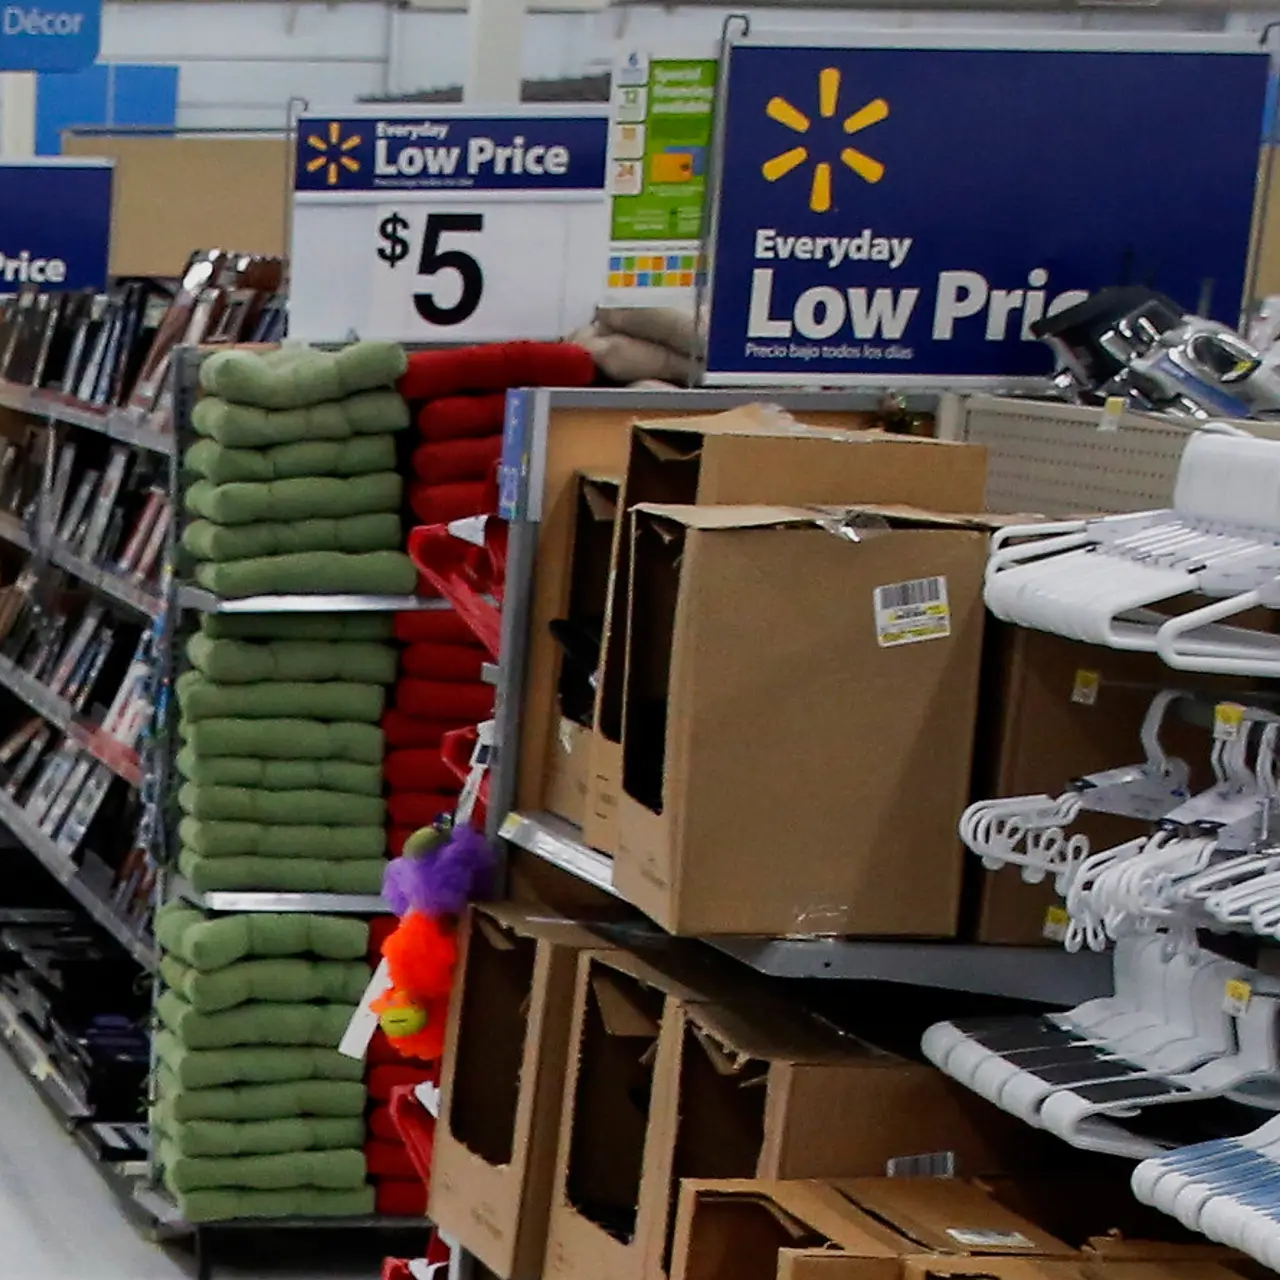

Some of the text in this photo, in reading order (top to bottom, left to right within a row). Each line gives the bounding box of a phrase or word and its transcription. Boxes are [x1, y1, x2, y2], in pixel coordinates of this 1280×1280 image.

[3, 7, 84, 36] Décor
[374, 121, 449, 139] Everyday
[373, 136, 570, 176] Low Price
[754, 229, 913, 269] Everyday
[746, 267, 920, 340] Low
